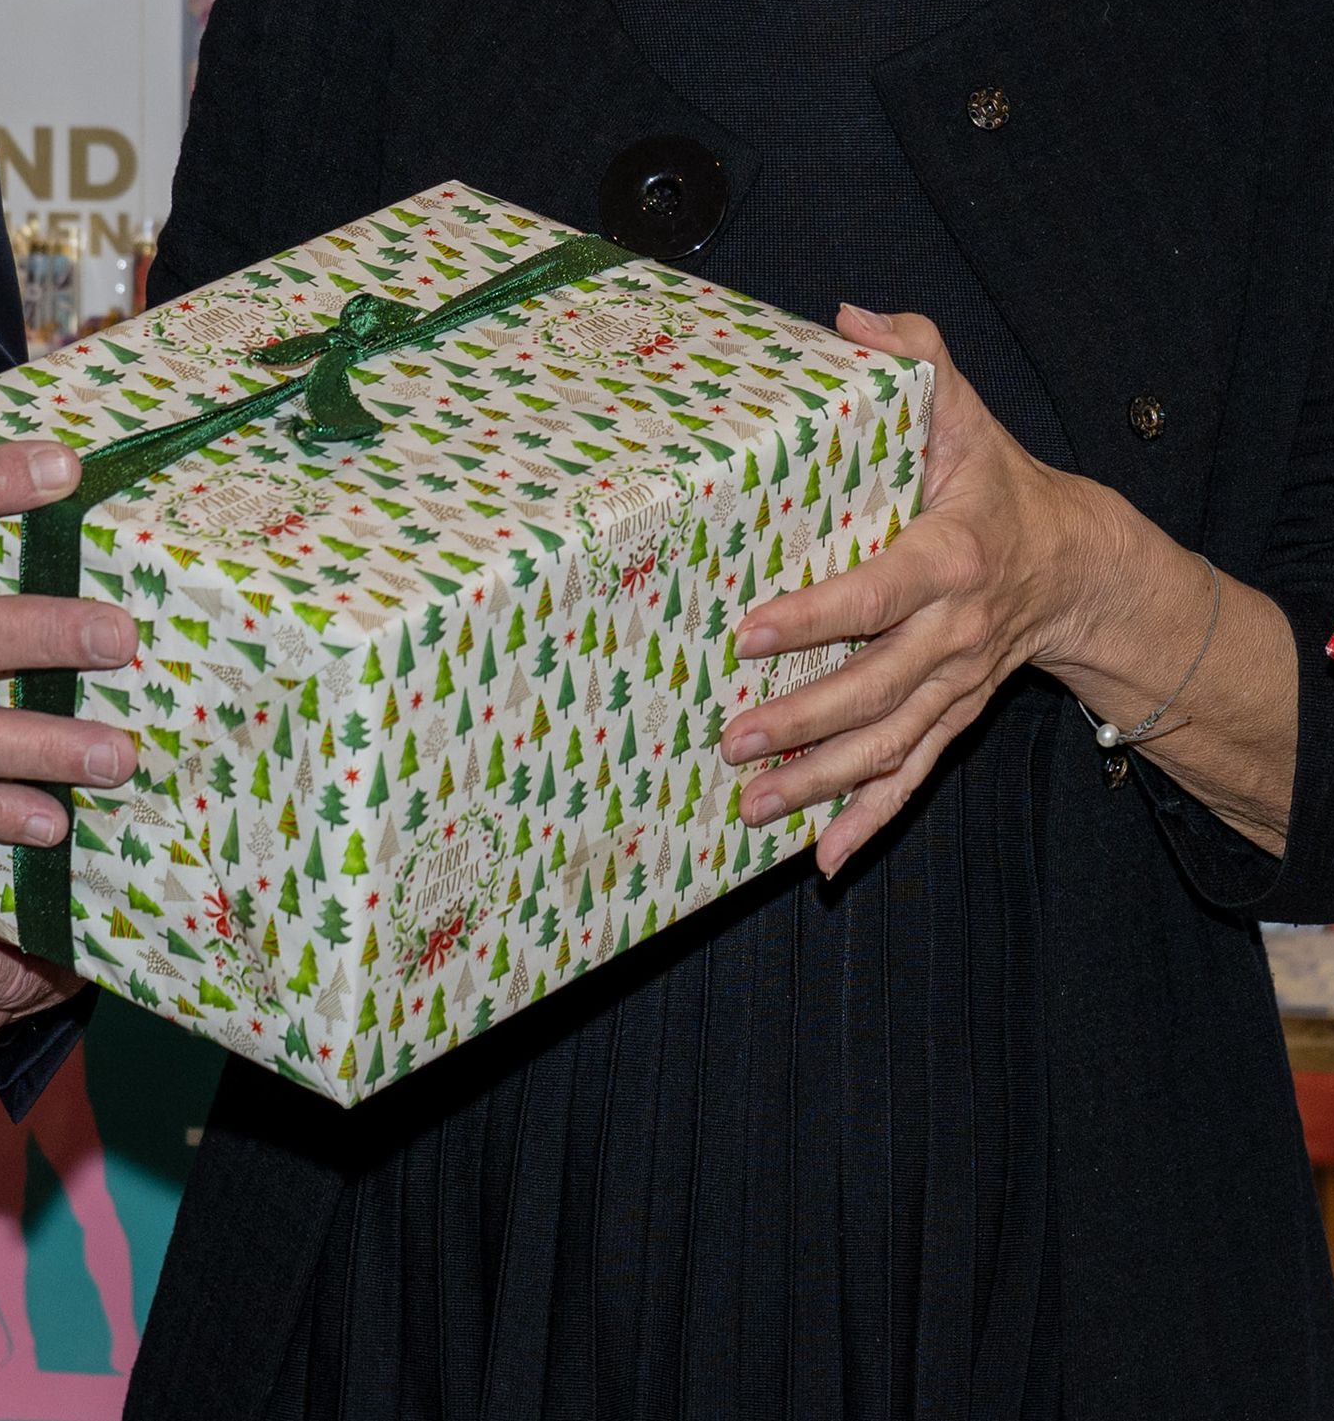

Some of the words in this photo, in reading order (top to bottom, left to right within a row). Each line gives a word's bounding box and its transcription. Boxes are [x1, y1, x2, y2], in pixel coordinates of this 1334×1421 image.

[181, 305, 235, 333] MERRY
[191, 309, 266, 344] CHRISTMAS
[569, 312, 620, 340] MERRY
[580, 312, 652, 351] CHRISTMAS
[602, 483, 654, 520] MERRY
[608, 495, 672, 548] CHRISTMAS
[425, 839, 469, 886] MERRY
[414, 858, 481, 913] CHRISTMAS
